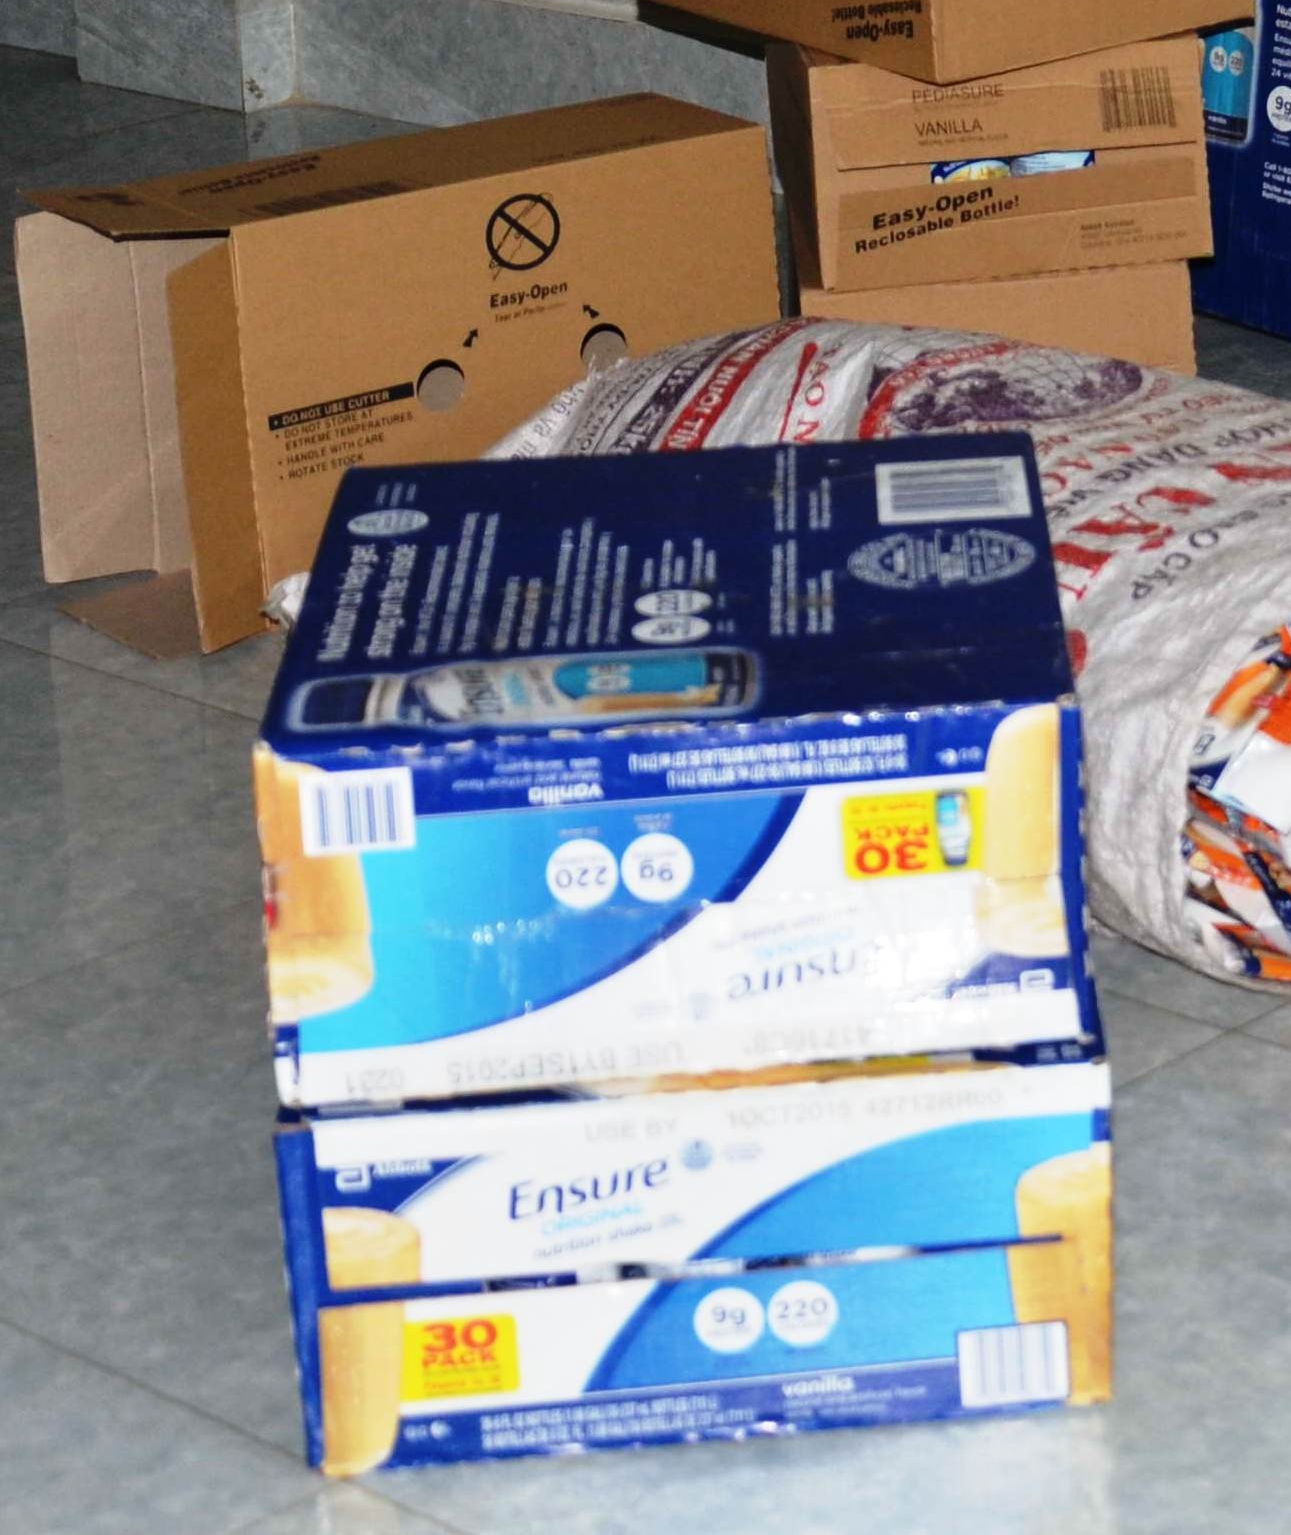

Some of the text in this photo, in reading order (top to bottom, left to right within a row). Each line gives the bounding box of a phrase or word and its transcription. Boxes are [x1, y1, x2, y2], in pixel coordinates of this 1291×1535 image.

[832, 0, 922, 21] Reclosable Bottle!
[846, 19, 914, 41] Easy-Open
[912, 84, 1004, 104] PEDIASURE
[914, 118, 983, 137] VANILLA
[871, 186, 994, 231] Easy-Open
[854, 195, 1021, 254] Reclosable Bottle!
[490, 282, 568, 307] Easy-Open
[282, 391, 390, 425] DO NOT USE CUTTER
[283, 410, 372, 438] DO NOT STORE AT
[286, 412, 413, 451] EXTREME TEMPERATURES
[287, 433, 384, 465] HANDLE WITH CARE
[288, 454, 363, 479] ROTATE STOCK
[528, 783, 603, 805] vanilla
[856, 824, 929, 843] PACK
[855, 841, 928, 873] 30
[555, 856, 674, 889] 9g 220
[727, 944, 865, 1002] nsure
[624, 1039, 683, 1075] USE
[509, 1157, 669, 1220] Ensure
[541, 1202, 645, 1237] ORIGINAL
[712, 1297, 829, 1326] 9g 220
[423, 1320, 498, 1353] 30
[422, 1350, 496, 1369] PACK
[782, 1377, 854, 1399] vanilla
